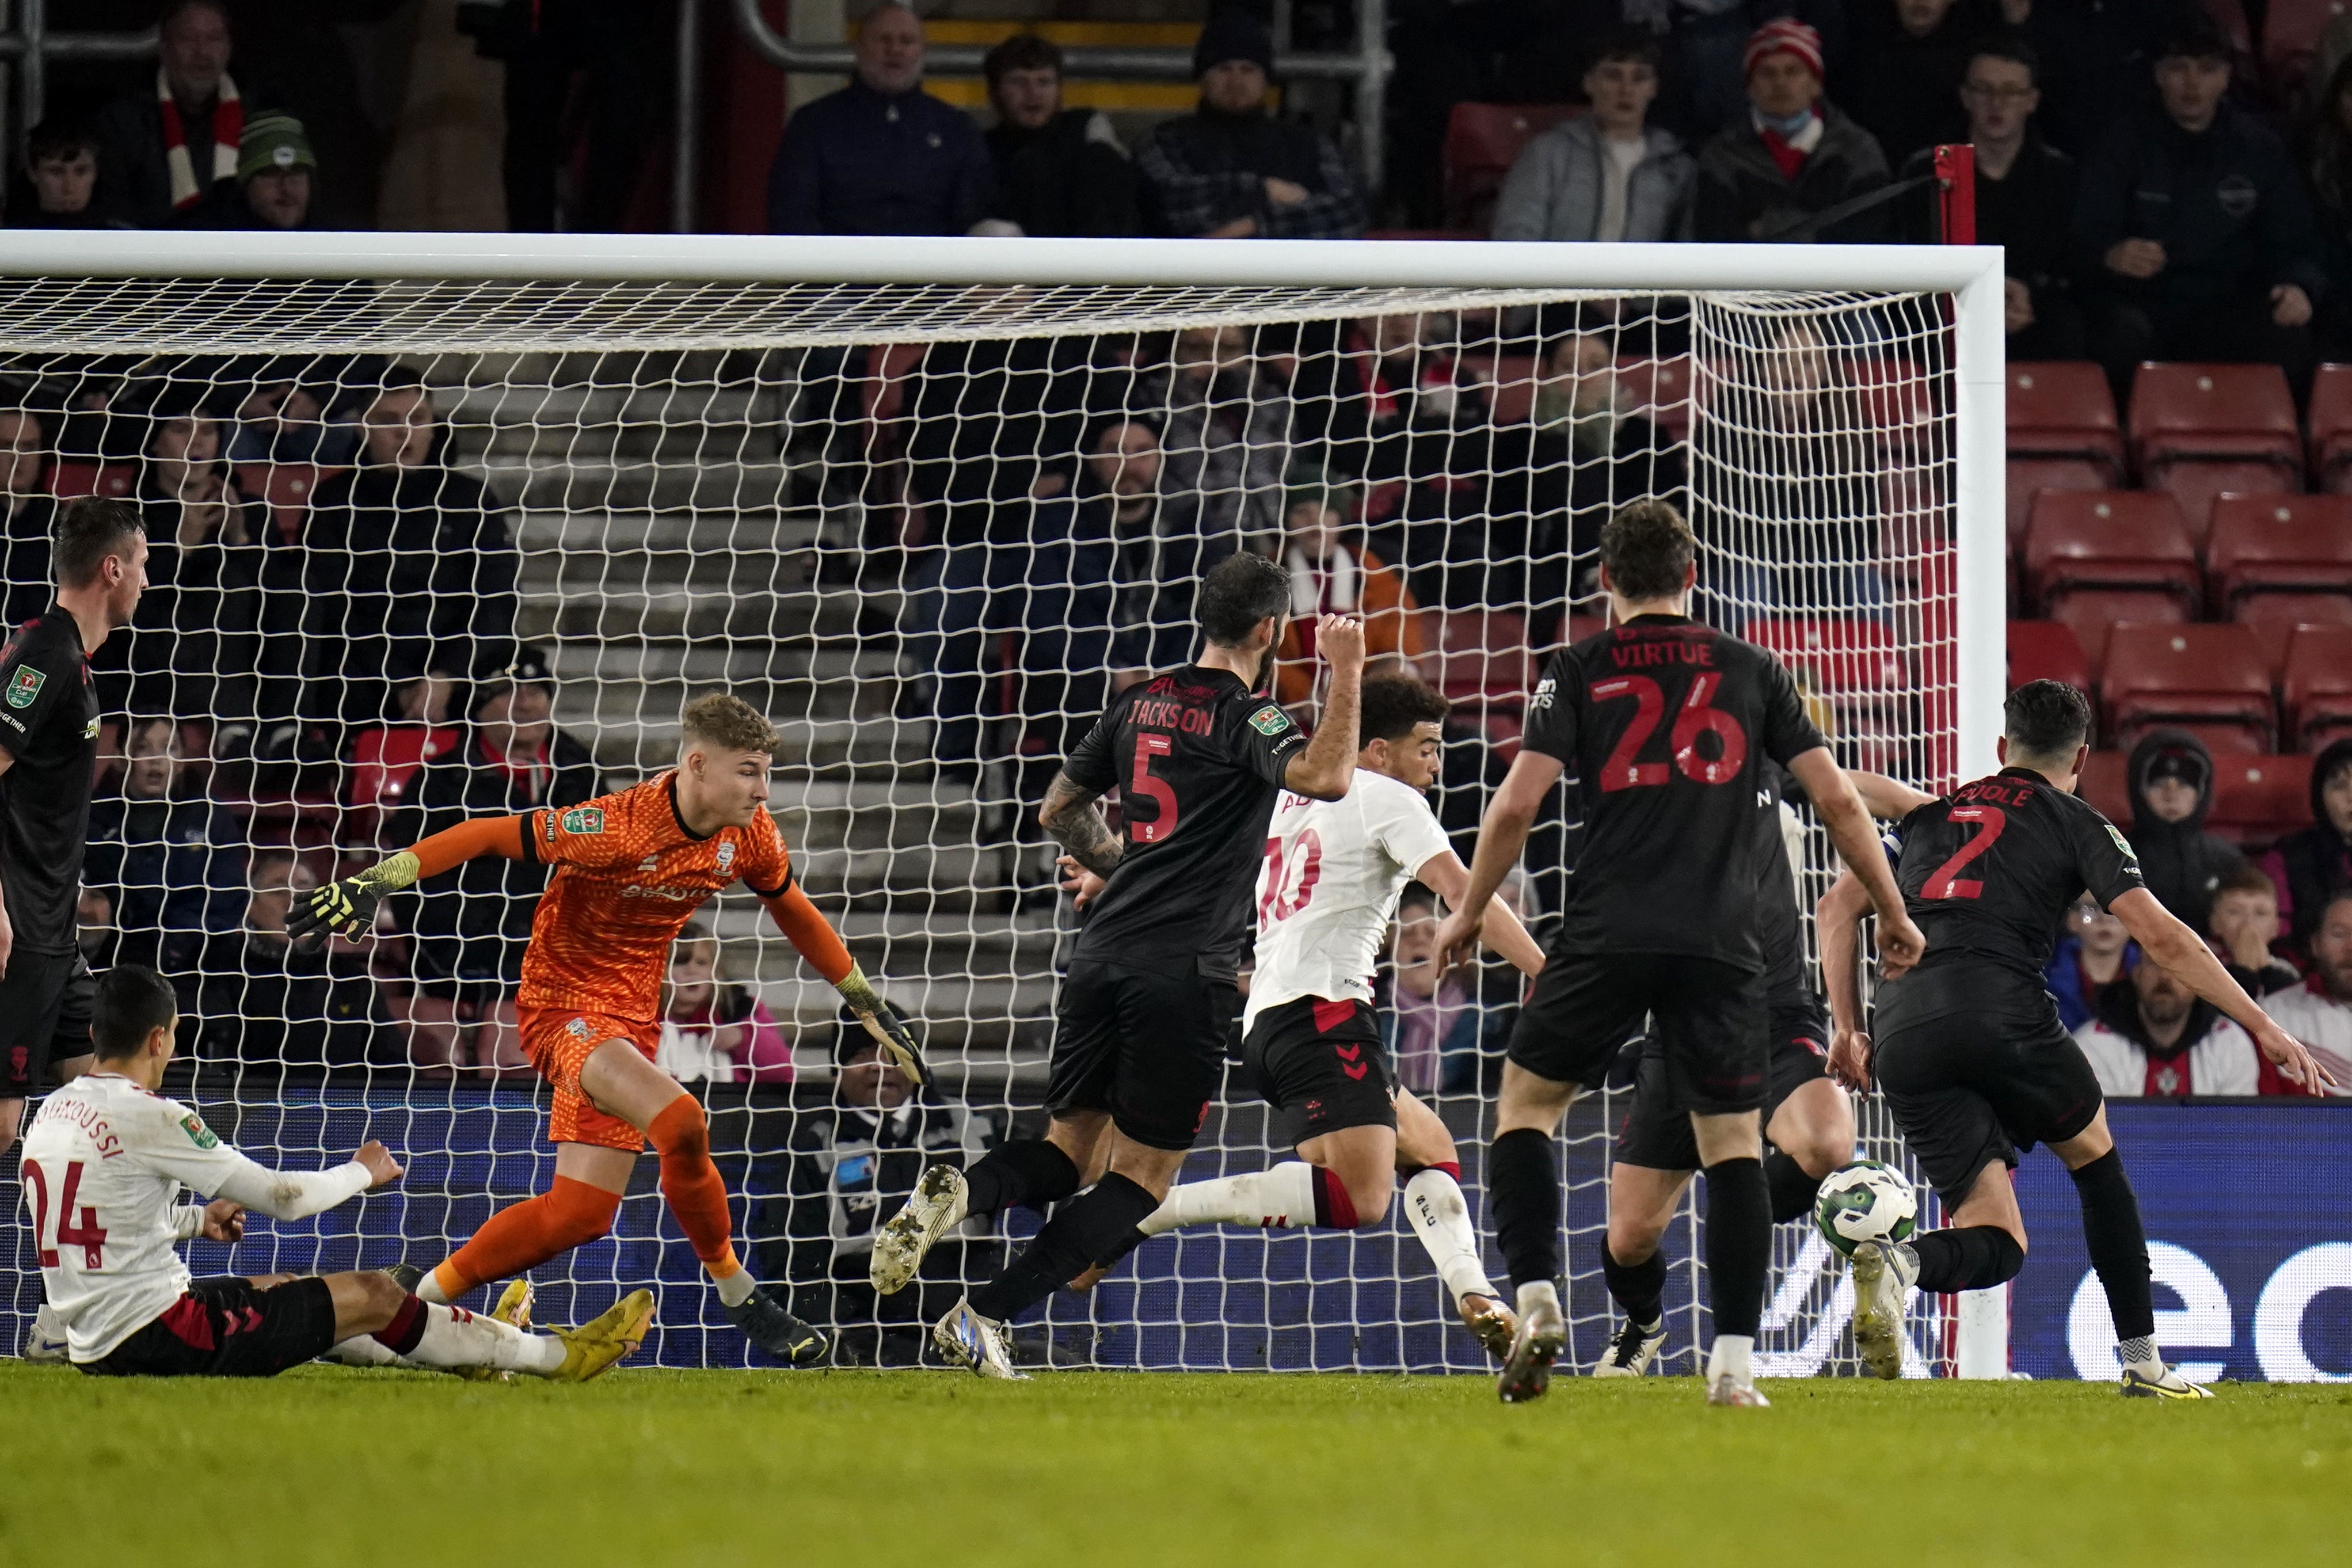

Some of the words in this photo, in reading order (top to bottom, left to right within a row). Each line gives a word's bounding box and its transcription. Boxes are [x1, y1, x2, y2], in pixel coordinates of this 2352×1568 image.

[1612, 641, 1714, 668] VIRTUE
[1128, 700, 1217, 736] JACKSON
[1590, 671, 1746, 793] 26
[1131, 732, 1178, 843] 5
[1260, 828, 1322, 934] 10
[1919, 804, 2005, 899] 2
[24, 1159, 108, 1269] 24
[1417, 1195, 1436, 1227] SFC
